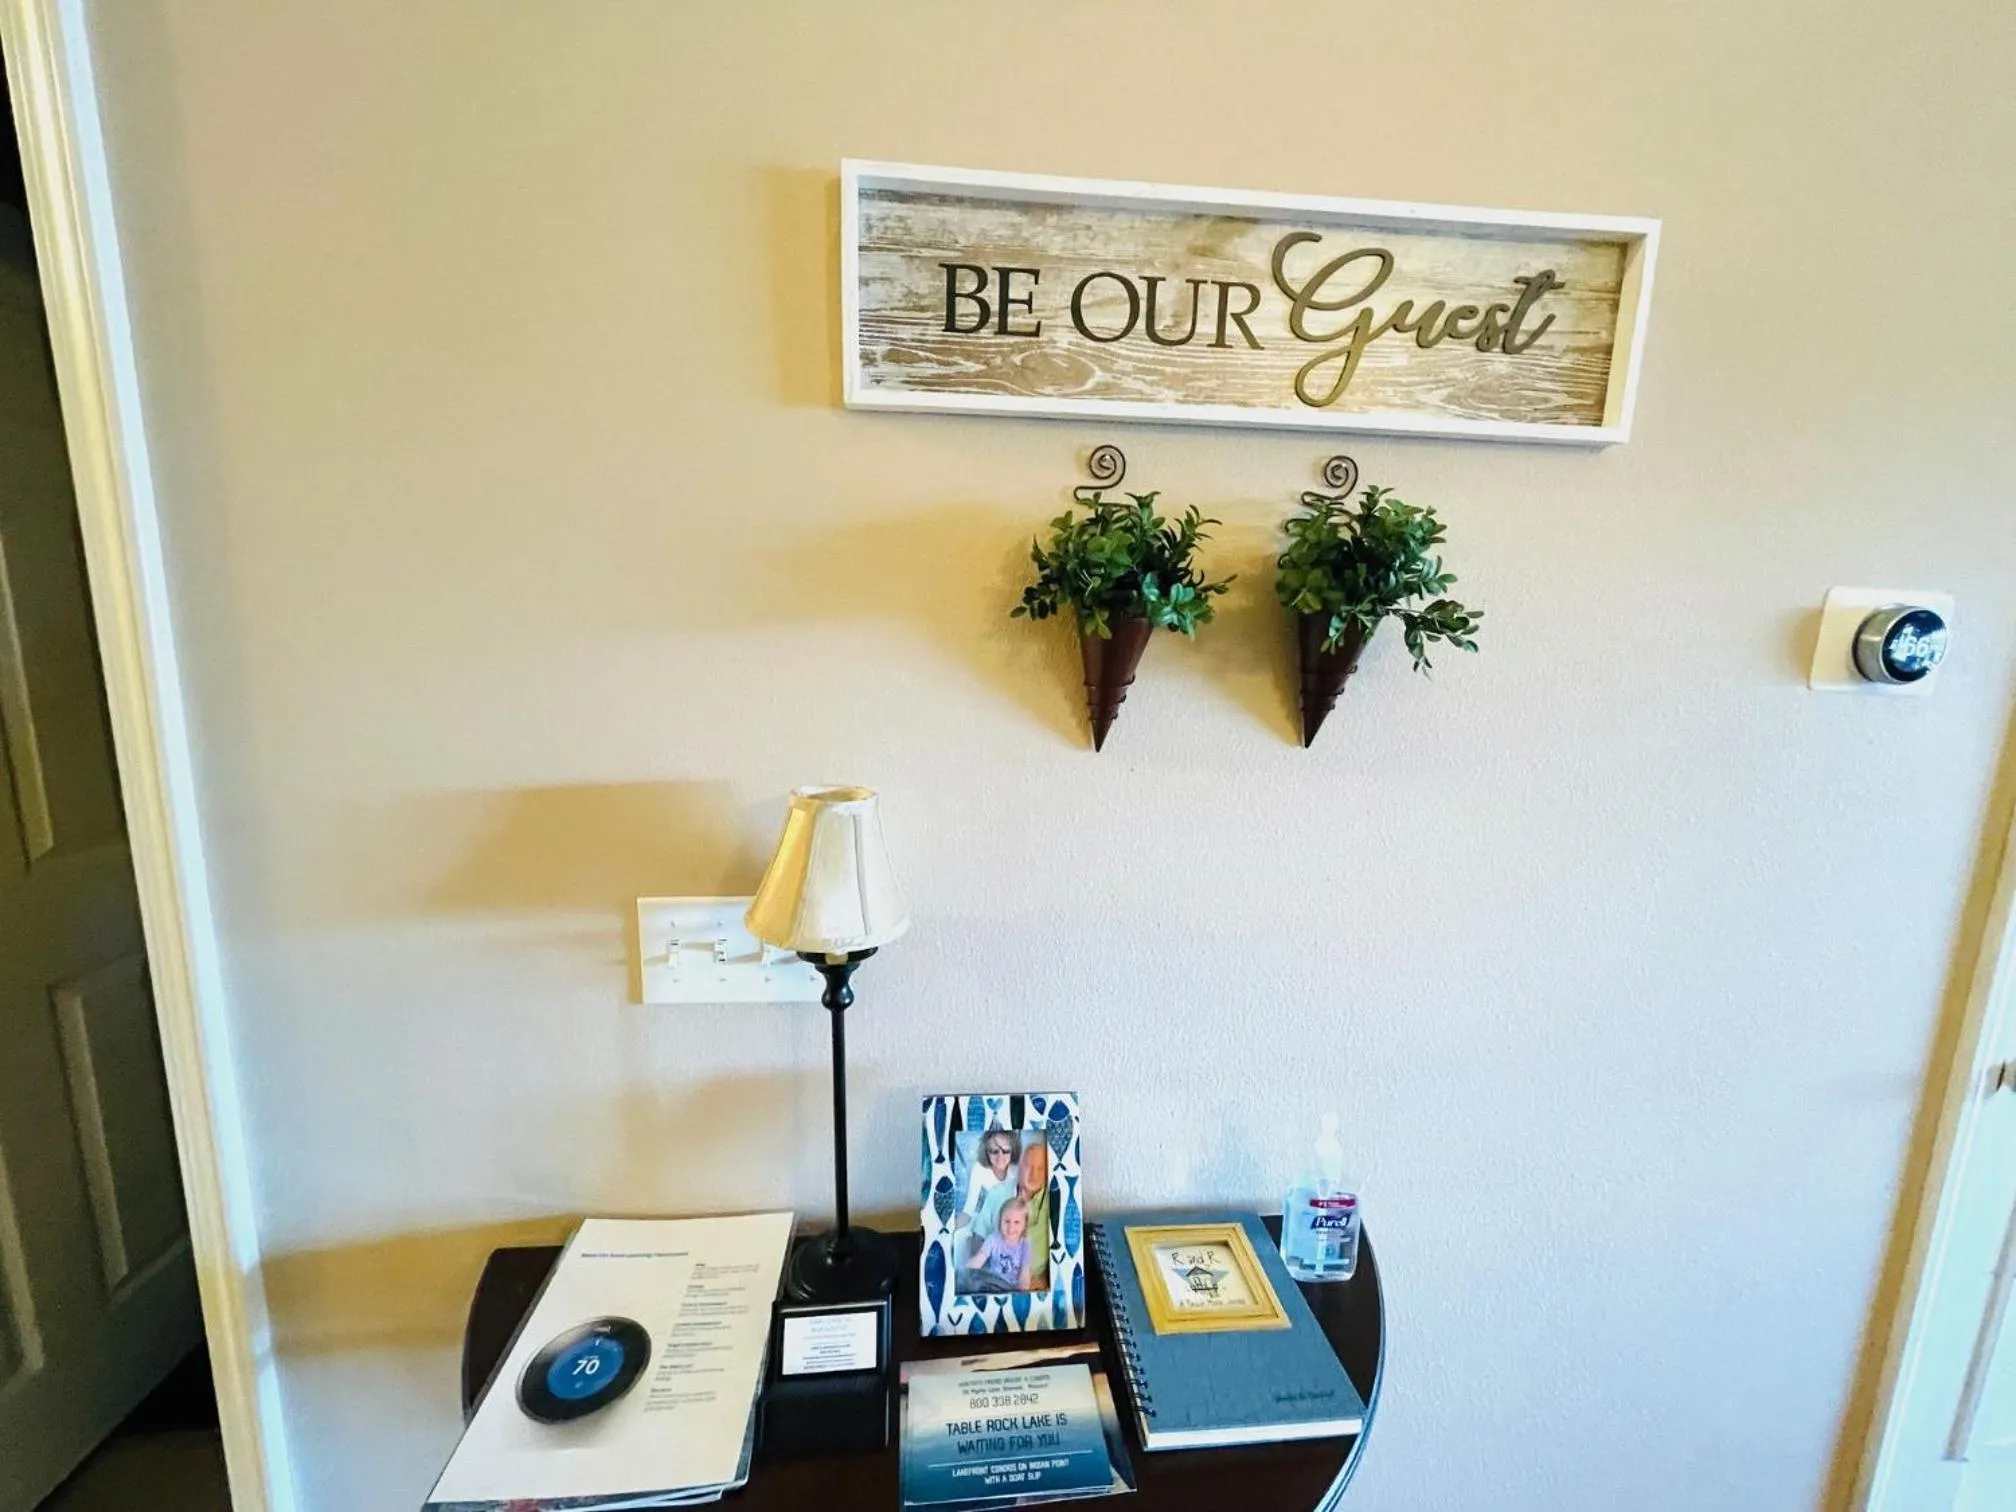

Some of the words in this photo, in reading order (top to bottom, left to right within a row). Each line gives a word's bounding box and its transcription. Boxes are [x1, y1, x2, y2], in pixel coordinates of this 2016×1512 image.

[938, 263, 1041, 338] BE
[1070, 272, 1265, 350] OUR
[1271, 231, 1566, 407] Guest
[572, 1358, 601, 1376] 70
[946, 1419, 982, 1437] TABLE
[987, 1416, 1019, 1433] ROCK
[1022, 1413, 1052, 1430] LAKE
[1055, 1412, 1068, 1426] IS
[1008, 1434, 1032, 1451] FOR
